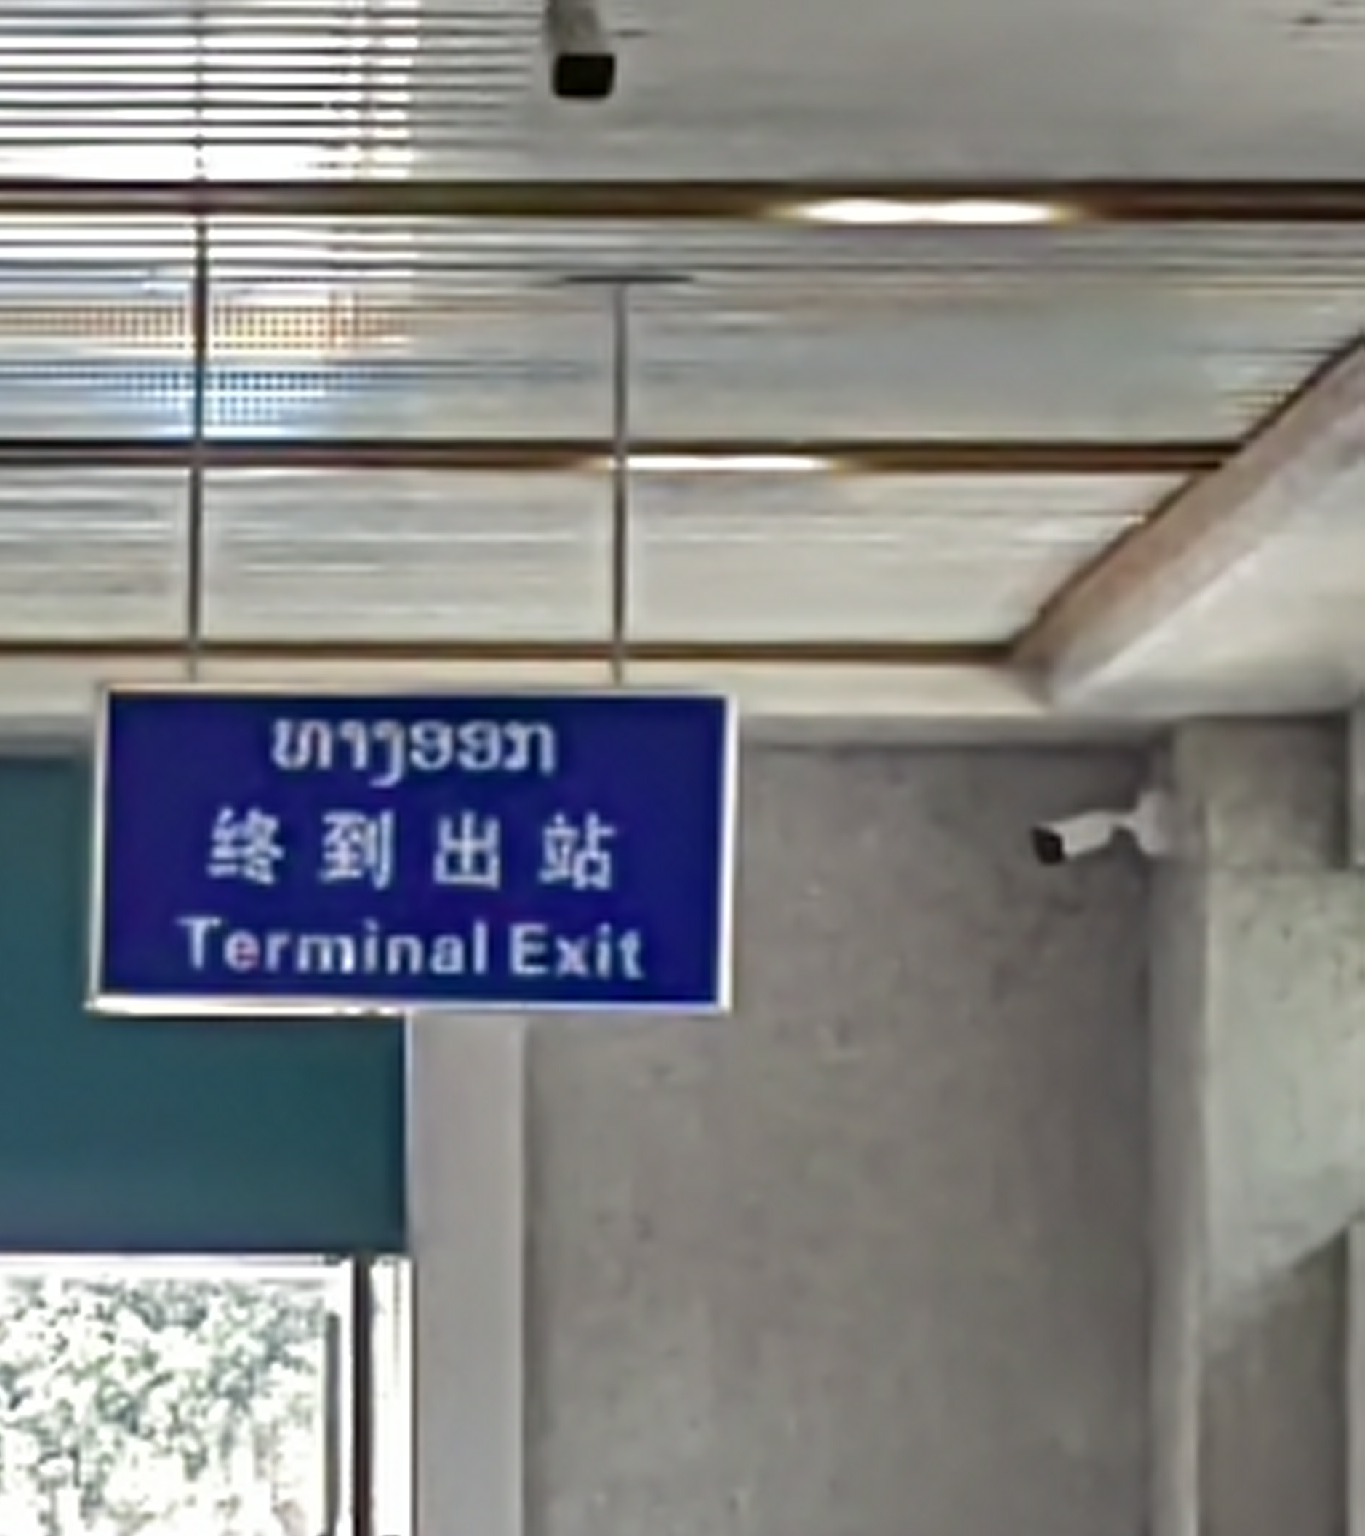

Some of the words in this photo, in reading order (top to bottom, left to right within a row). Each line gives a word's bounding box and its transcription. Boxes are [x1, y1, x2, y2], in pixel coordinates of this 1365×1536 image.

[271, 717, 557, 788] ທາງອອກ
[207, 806, 616, 891] 终到出站
[178, 914, 489, 975] Terminal
[508, 921, 644, 980] Exit
